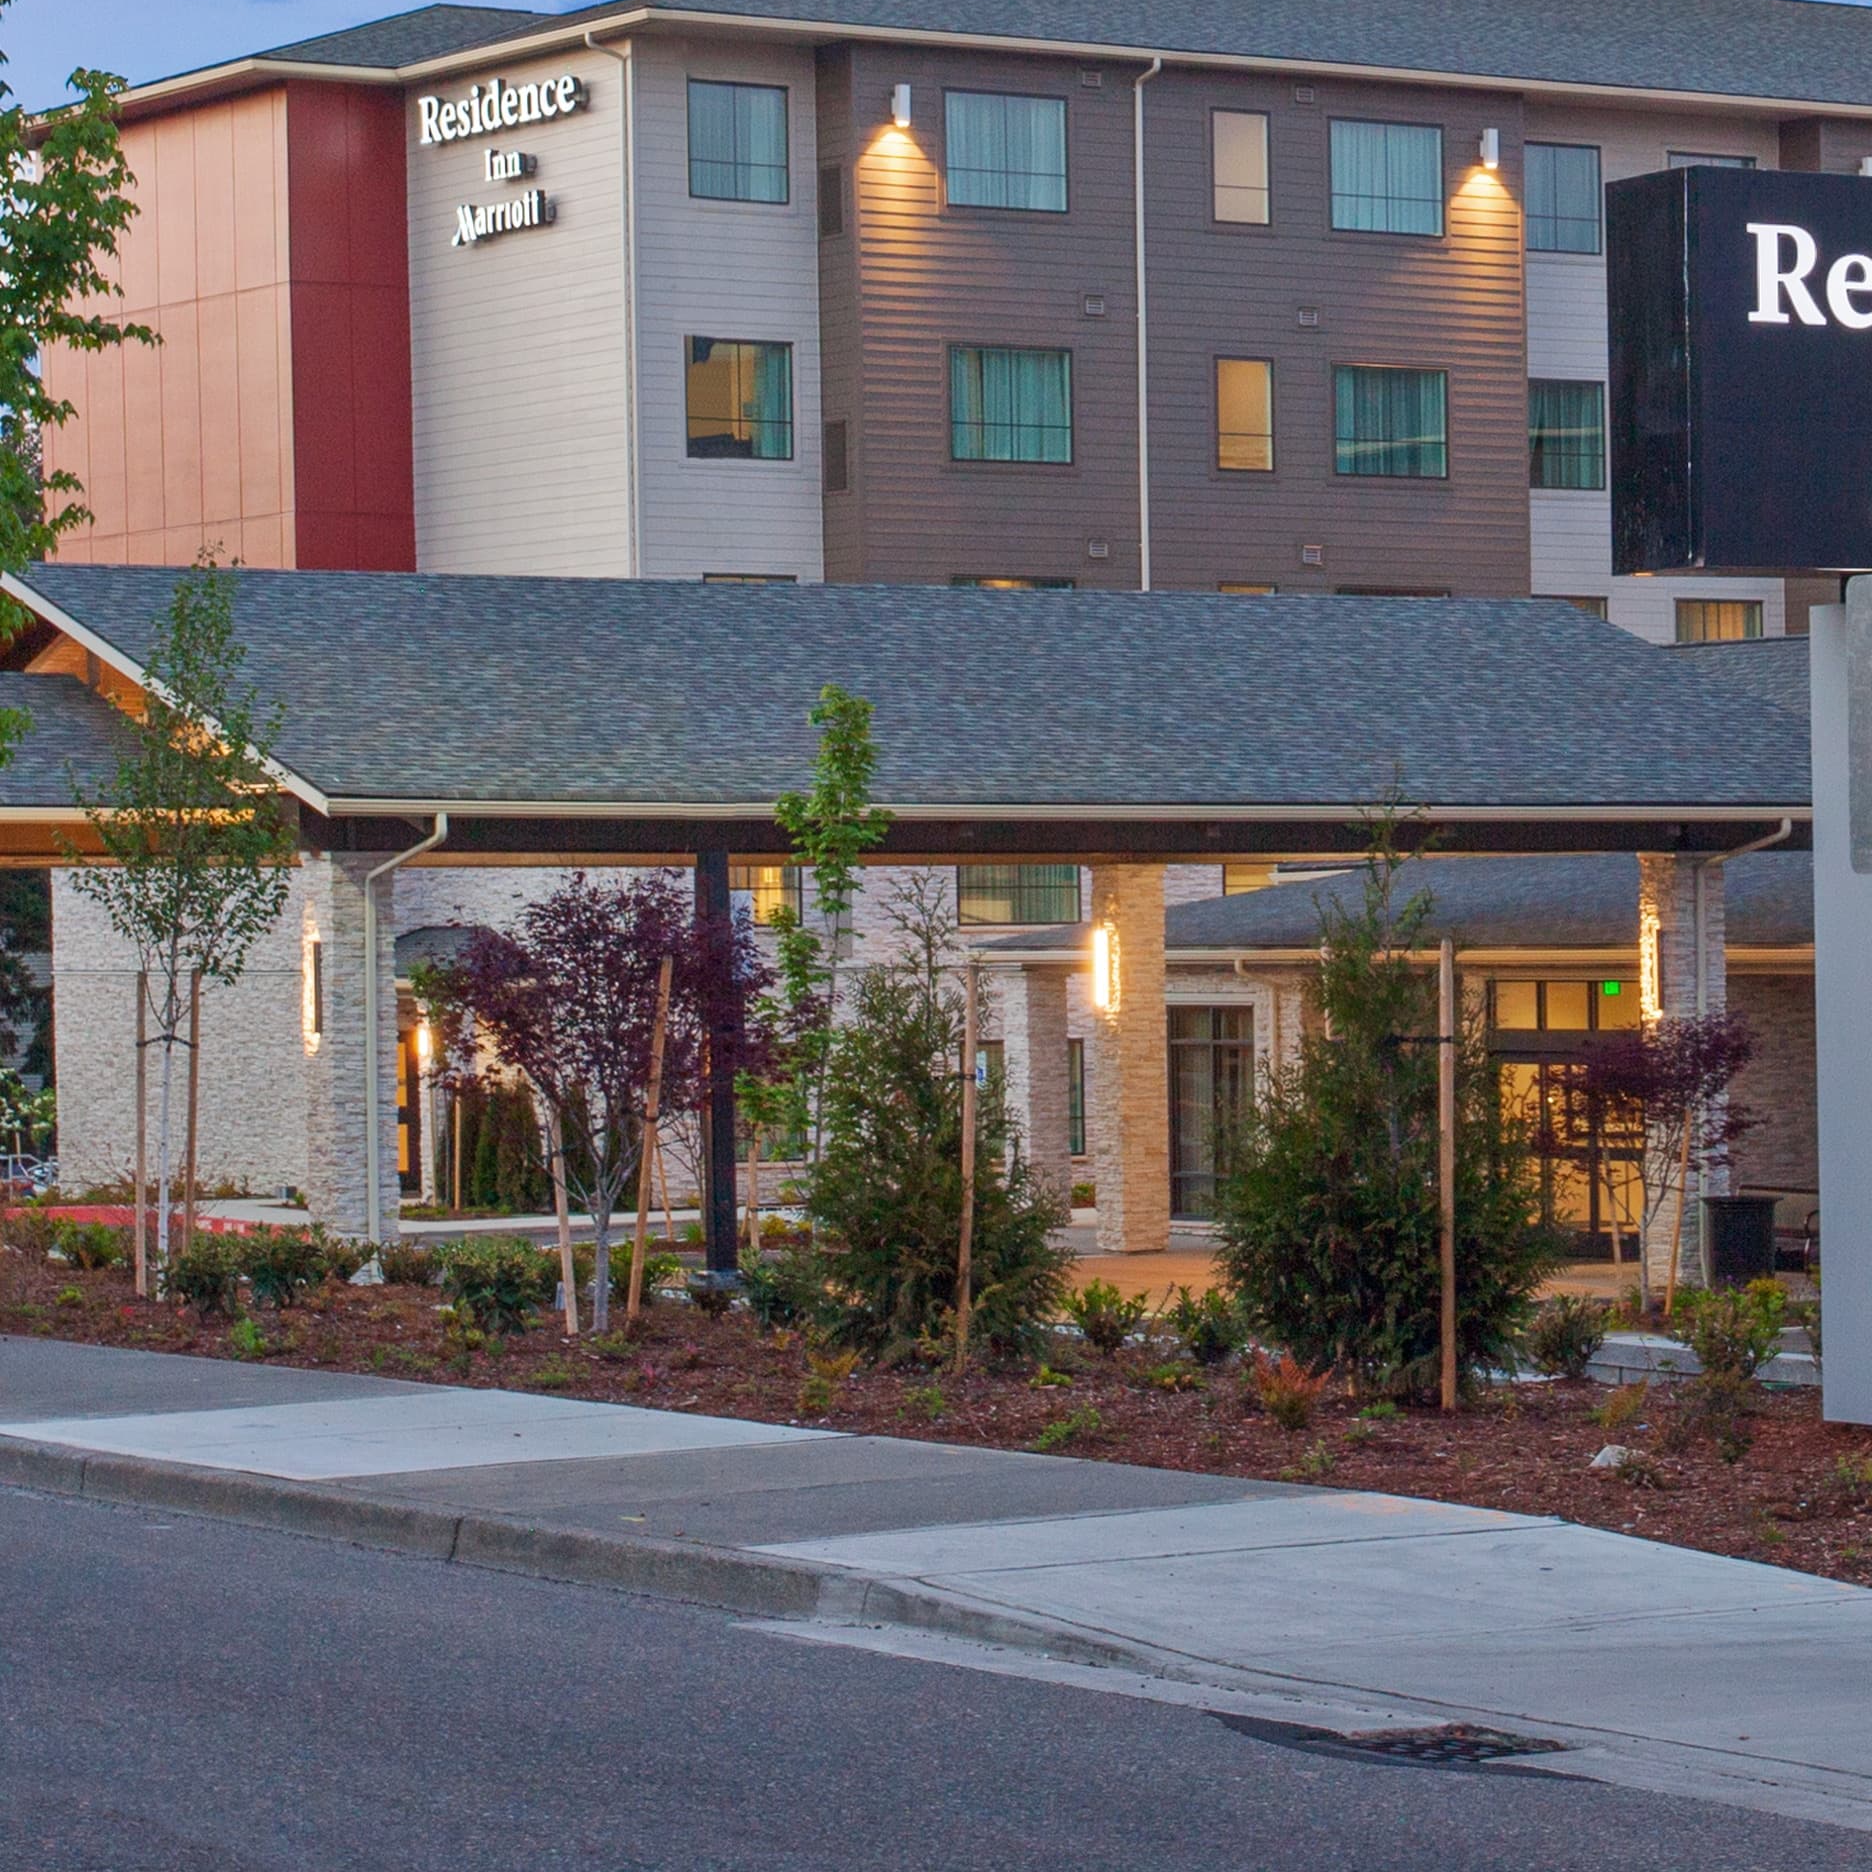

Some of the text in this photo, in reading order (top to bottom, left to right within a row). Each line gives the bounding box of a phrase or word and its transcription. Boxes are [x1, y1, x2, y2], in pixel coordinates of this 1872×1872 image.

[418, 74, 577, 144] Residence
[484, 148, 522, 181] Inn
[451, 189, 540, 246] Marriott
